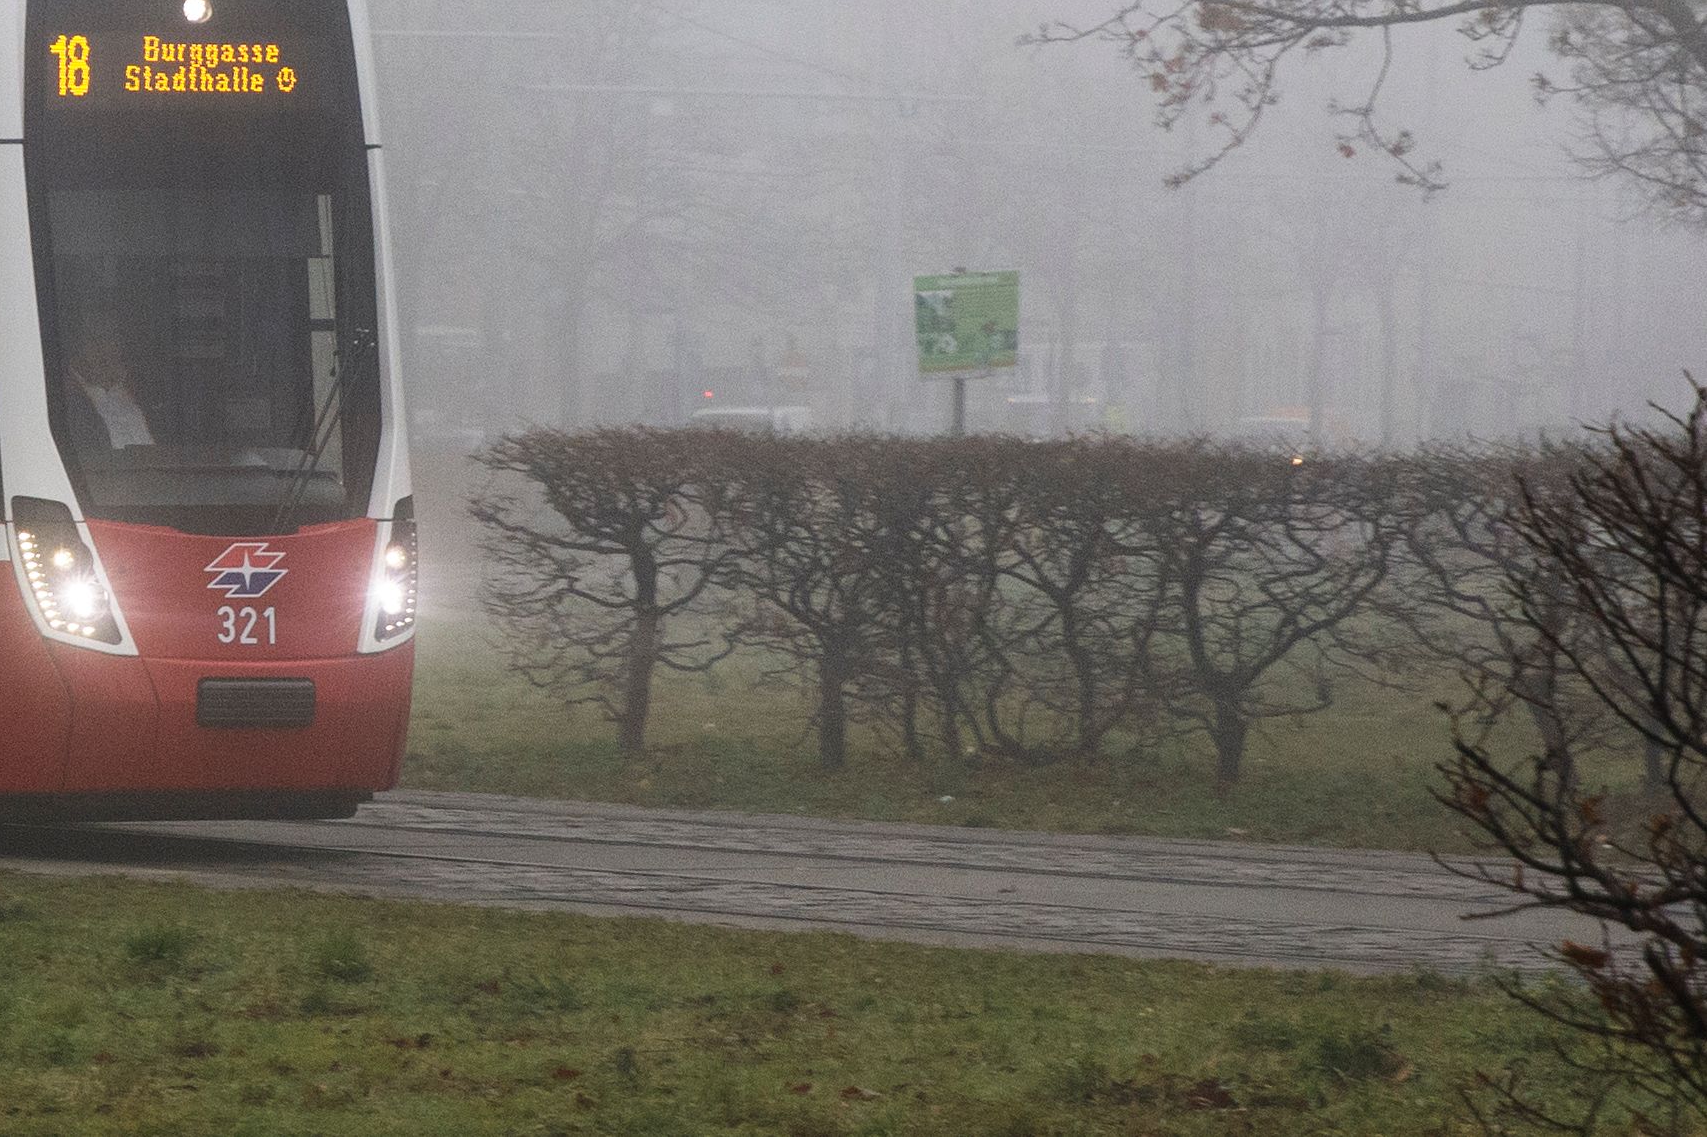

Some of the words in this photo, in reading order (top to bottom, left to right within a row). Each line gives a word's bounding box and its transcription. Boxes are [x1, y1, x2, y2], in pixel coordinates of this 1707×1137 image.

[49, 34, 90, 97] 18
[143, 35, 280, 68] Burggasse
[125, 65, 264, 93] Stadthalle
[217, 605, 276, 645] 321
